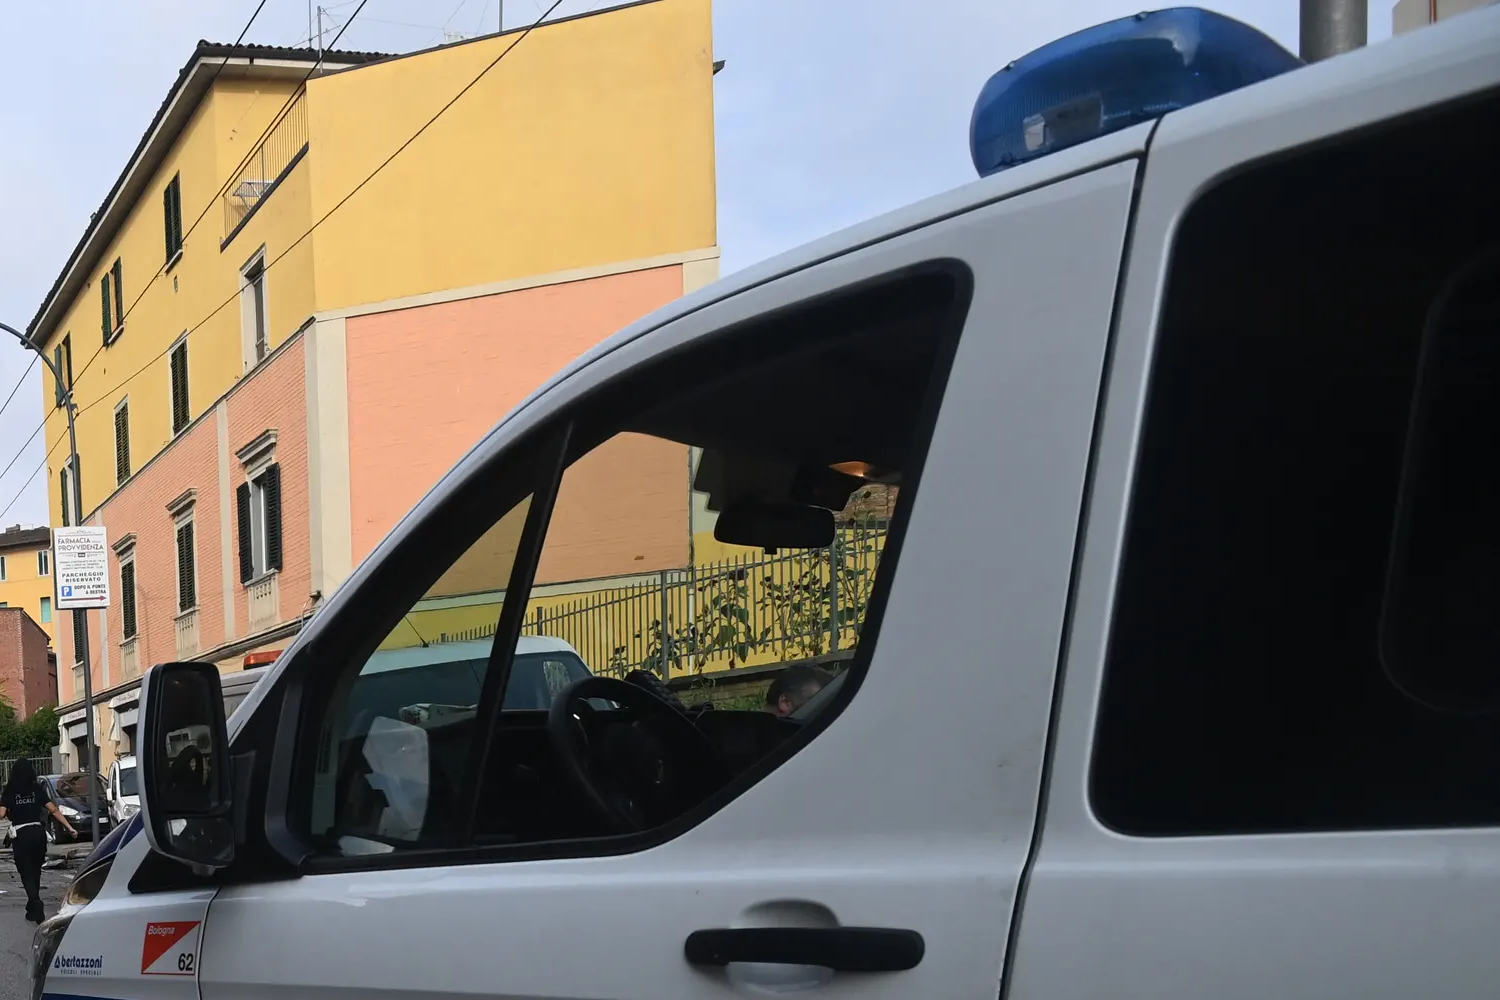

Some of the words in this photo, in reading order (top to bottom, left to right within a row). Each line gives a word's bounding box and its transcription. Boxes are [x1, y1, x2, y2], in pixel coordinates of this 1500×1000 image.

[147, 925, 176, 937] Bologna
[61, 955, 103, 969] bertazzoni
[178, 953, 194, 971] 62
